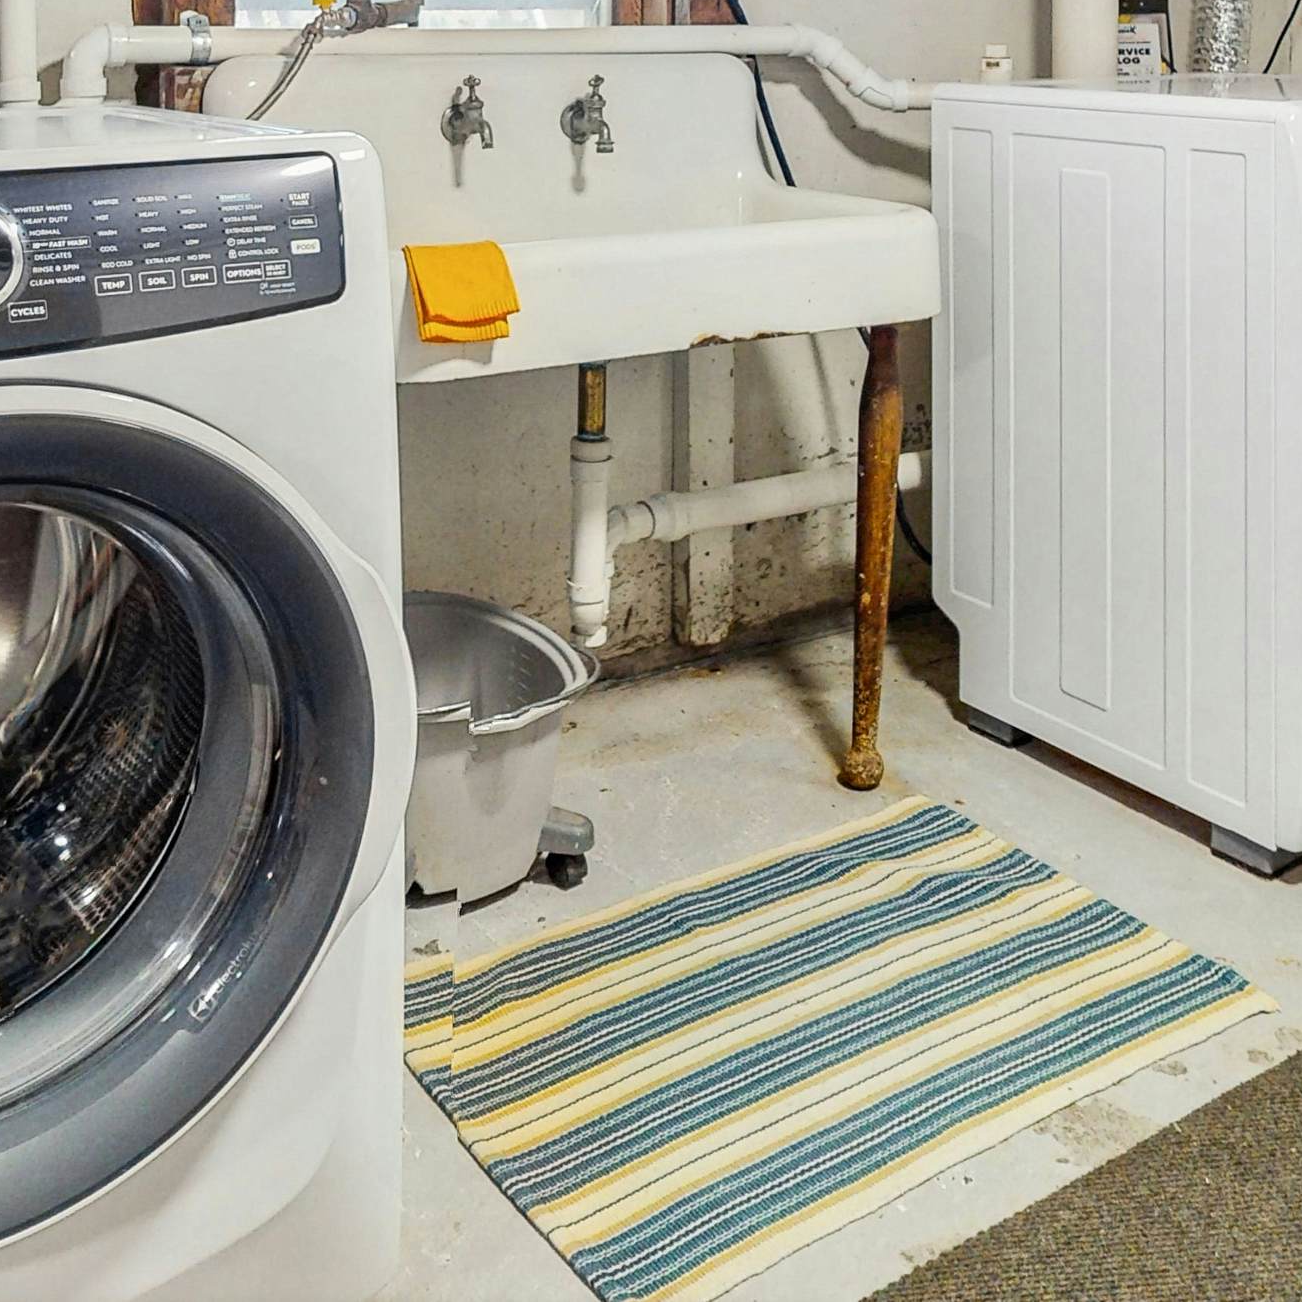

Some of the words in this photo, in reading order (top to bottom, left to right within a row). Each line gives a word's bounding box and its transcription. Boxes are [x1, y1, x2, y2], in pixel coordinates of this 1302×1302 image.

[288, 192, 310, 201] START
[13, 205, 44, 213] WHITEST
[45, 203, 73, 212] WHITES
[22, 217, 47, 225] HEAVY
[49, 215, 69, 224] DUTY
[29, 228, 61, 237] NORMAL
[49, 240, 67, 248] FAST
[67, 238, 88, 247] WASH
[99, 245, 118, 253] COOL
[34, 251, 73, 262] DELICATES
[144, 257, 164, 265] EXTRA
[164, 255, 181, 263] LIGHT
[115, 259, 134, 267] COLD
[265, 263, 286, 271] SELECT
[32, 264, 54, 274] RINSE
[62, 263, 80, 272] SPIN
[226, 268, 262, 278] OPTIONS
[29, 277, 55, 287] CLEAN
[55, 275, 86, 285] WASHER
[147, 276, 167, 286] SOIL
[189, 272, 209, 282] SPIN
[101, 280, 126, 290] TEMP
[10, 305, 45, 317] CYCLES
[211, 928, 261, 995] electrolu
